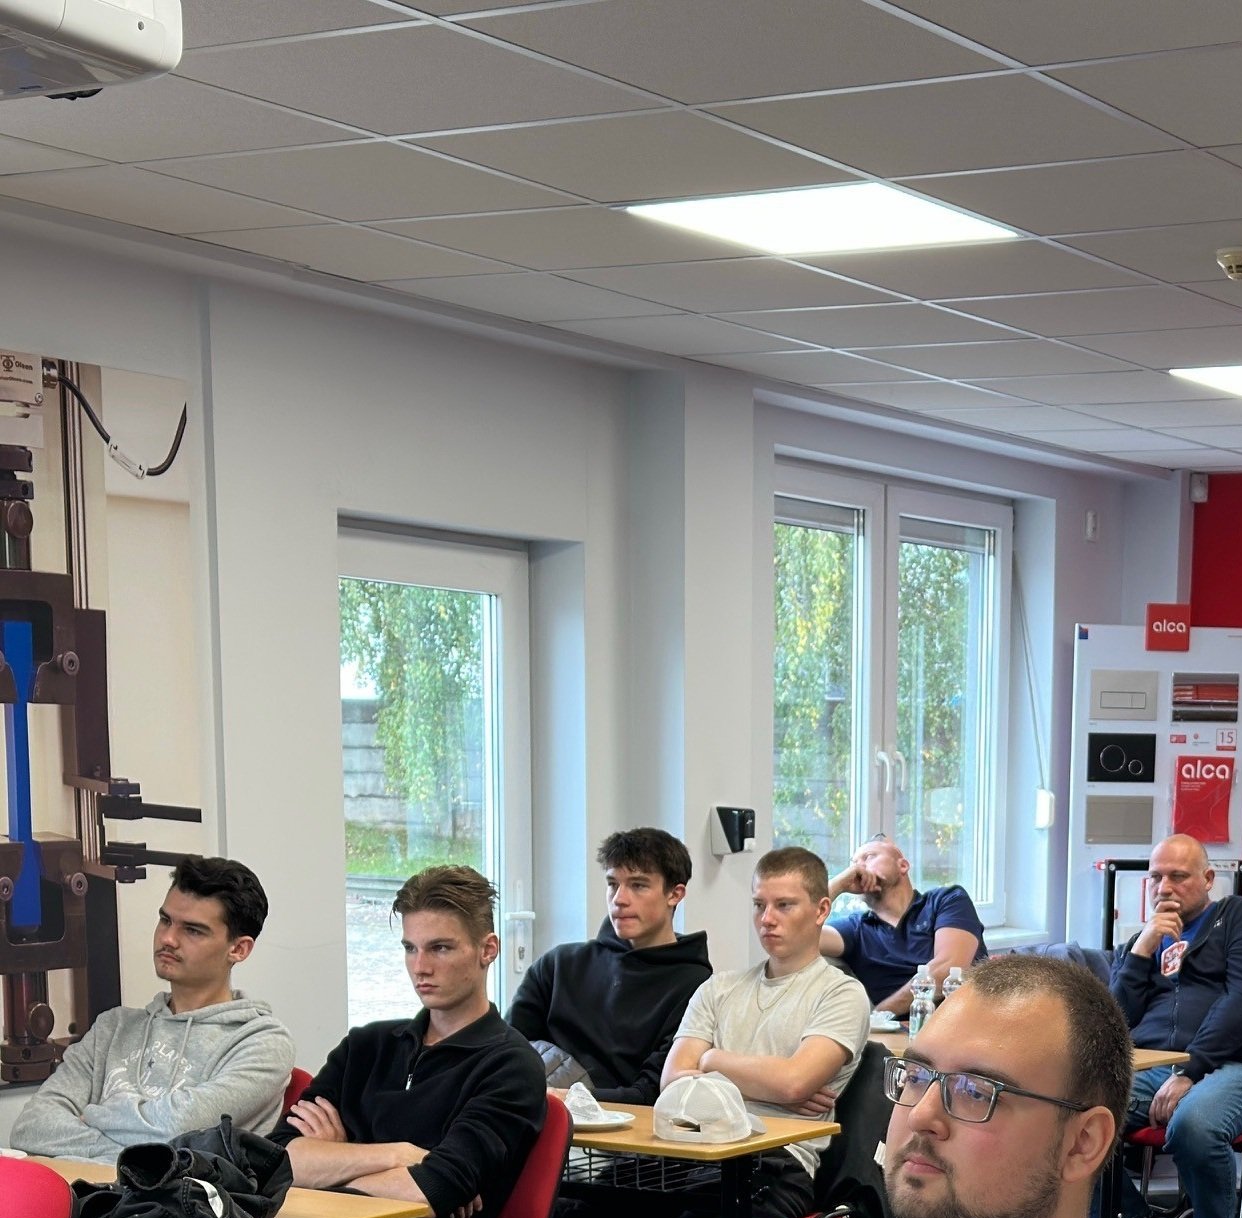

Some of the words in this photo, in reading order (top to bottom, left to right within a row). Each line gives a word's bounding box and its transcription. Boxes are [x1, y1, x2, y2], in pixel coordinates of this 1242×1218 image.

[1152, 619, 1186, 632] alca
[1220, 731, 1234, 744] 15
[1181, 760, 1229, 779] alca
